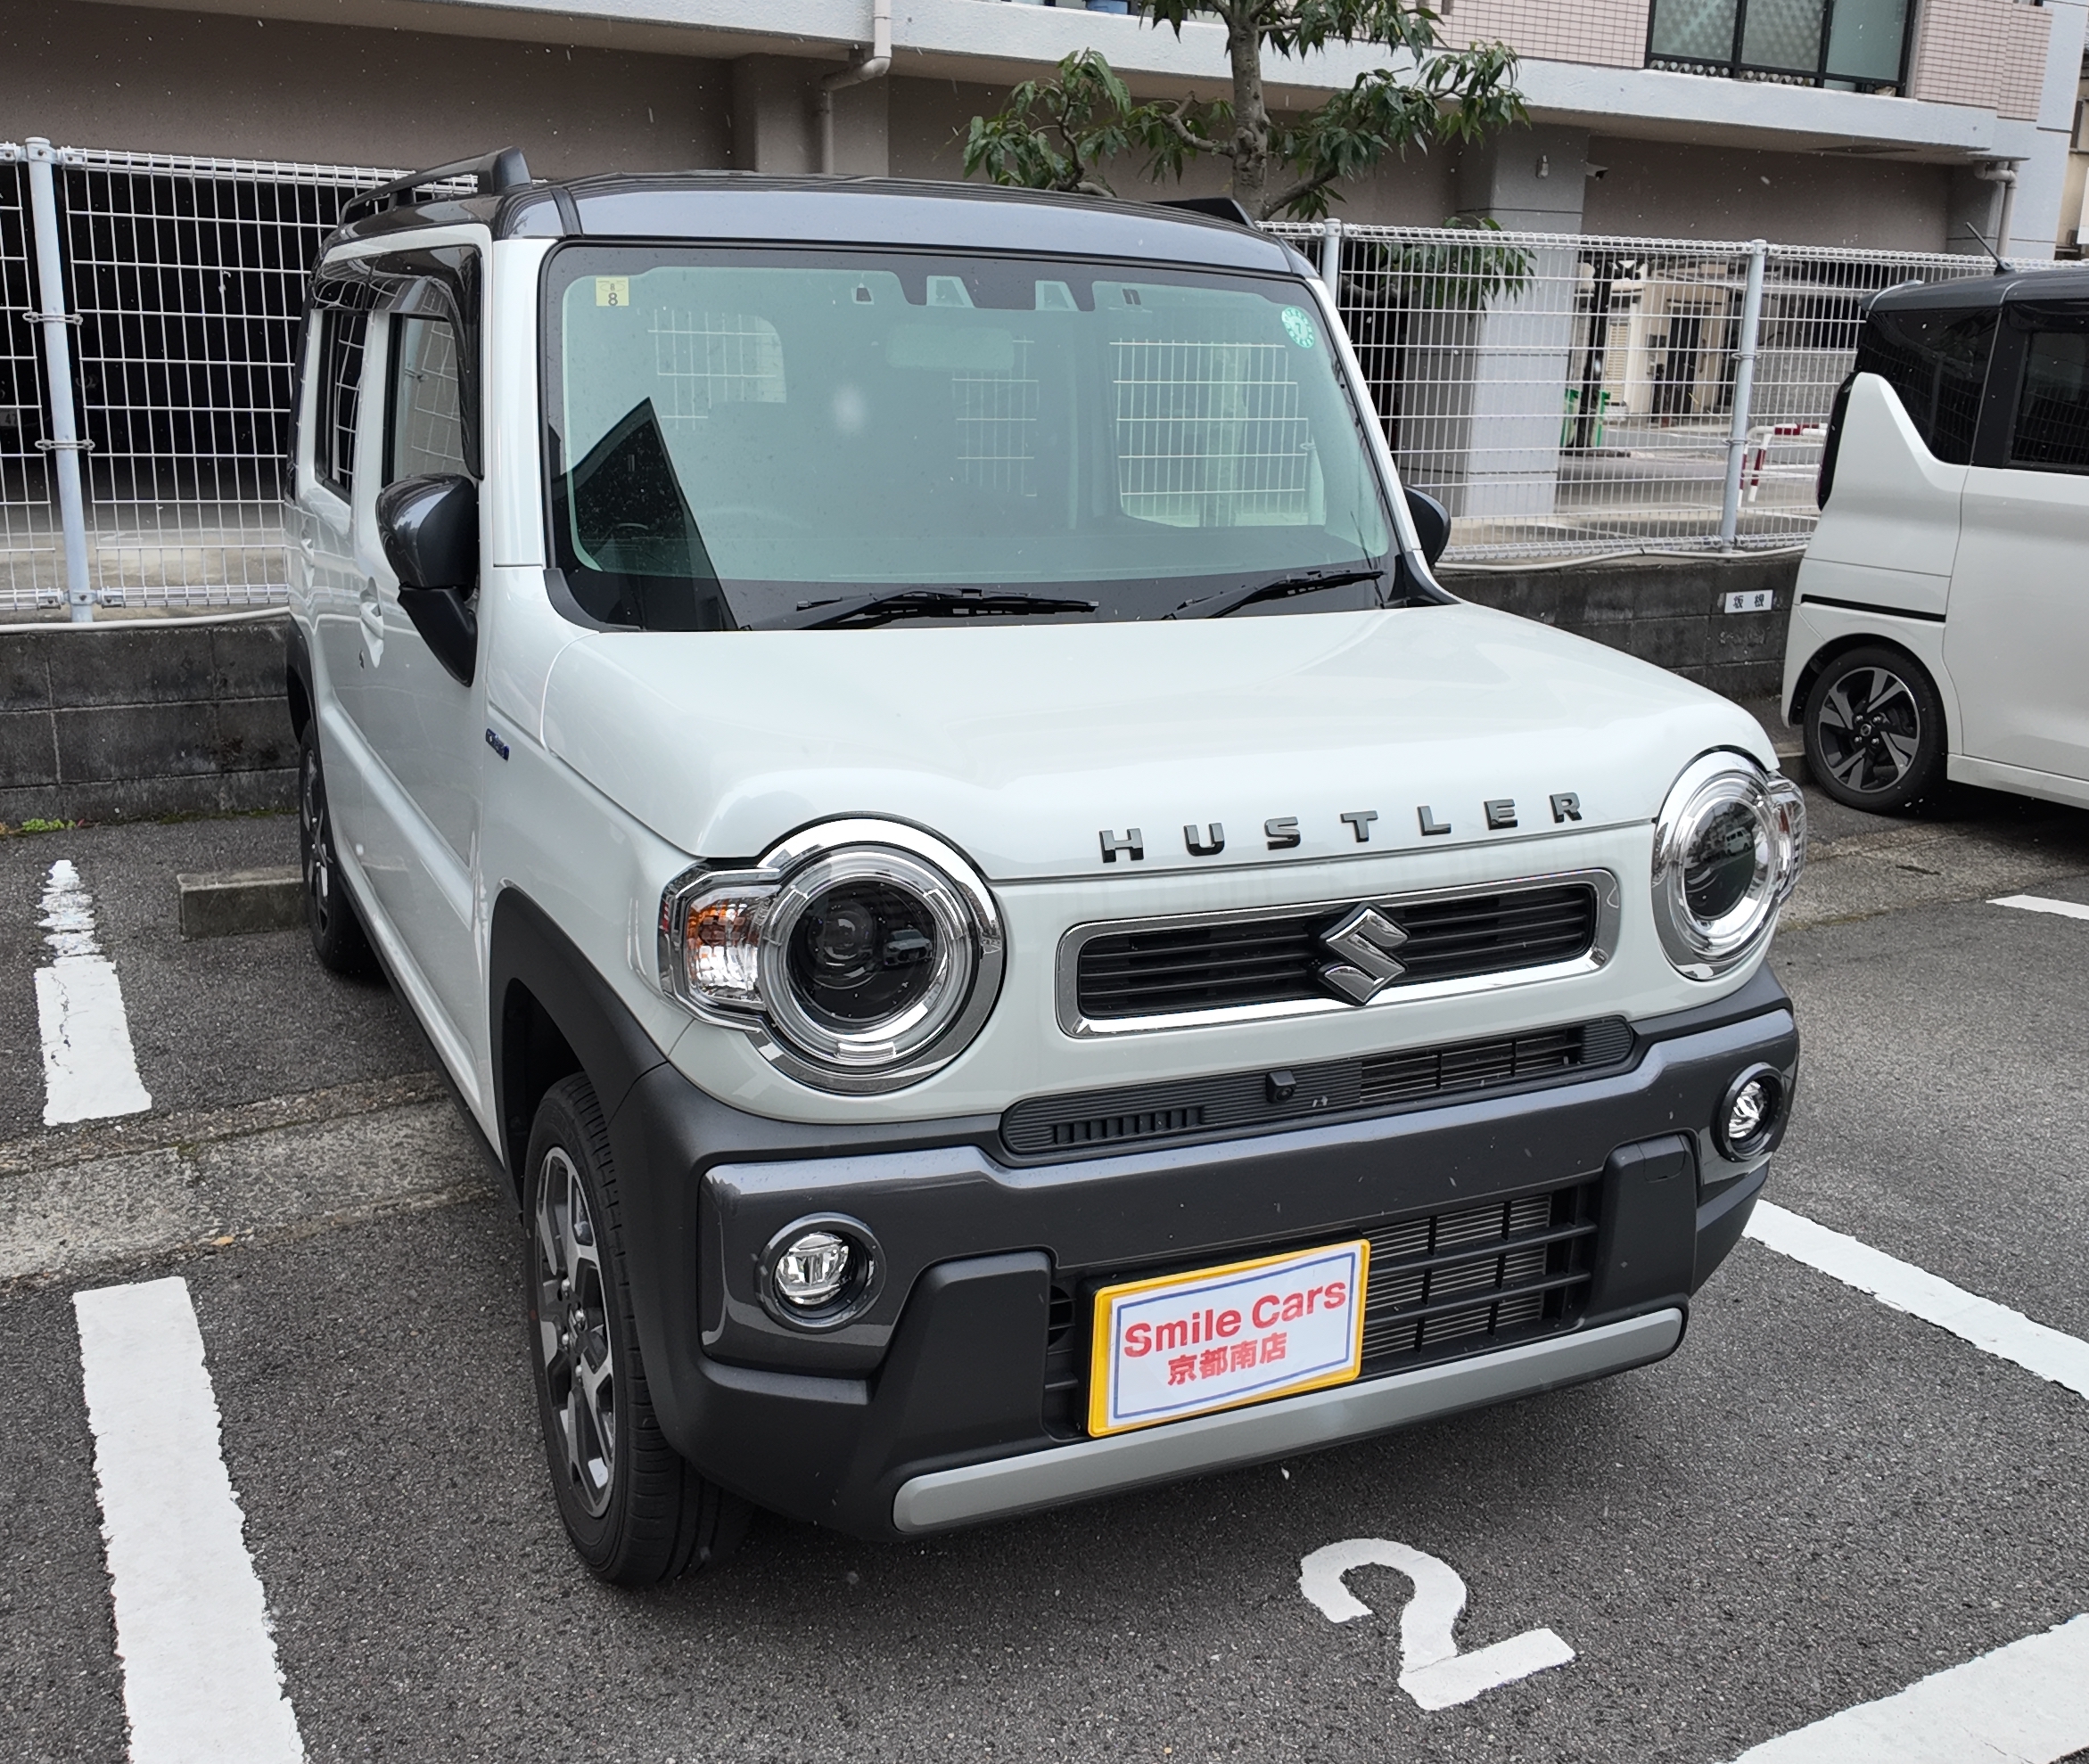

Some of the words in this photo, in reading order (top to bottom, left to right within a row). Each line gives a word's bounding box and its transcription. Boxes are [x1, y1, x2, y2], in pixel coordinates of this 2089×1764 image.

[608, 292, 618, 306] 8
[1295, 323, 1302, 334] 7
[1099, 792, 1583, 863] HUSTLER
[1124, 1309, 1242, 1358] Smile
[1252, 1282, 1346, 1328] Cars
[1168, 1333, 1287, 1386] 京都南店
[1298, 1538, 1576, 1711] 2
